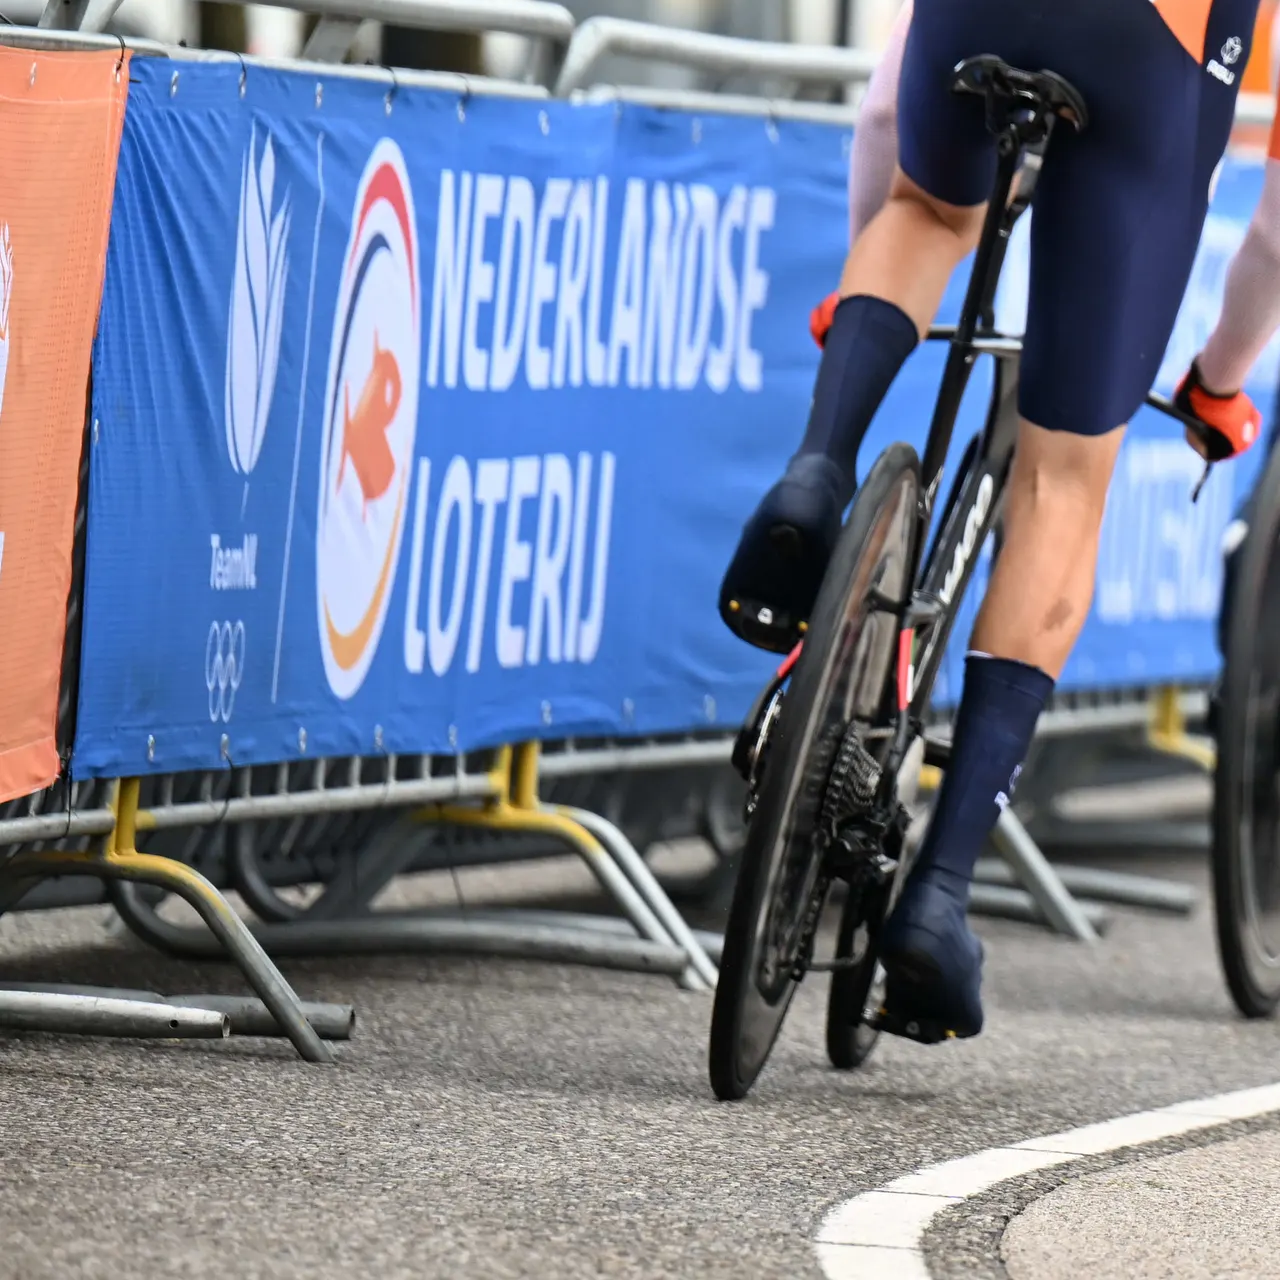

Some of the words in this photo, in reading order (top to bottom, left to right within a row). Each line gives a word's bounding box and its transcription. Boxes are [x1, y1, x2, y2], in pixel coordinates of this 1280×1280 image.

[426, 168, 777, 394] NEDERLANDSE
[209, 533, 258, 590] TeamNL
[403, 450, 617, 678] LOTERIJ
